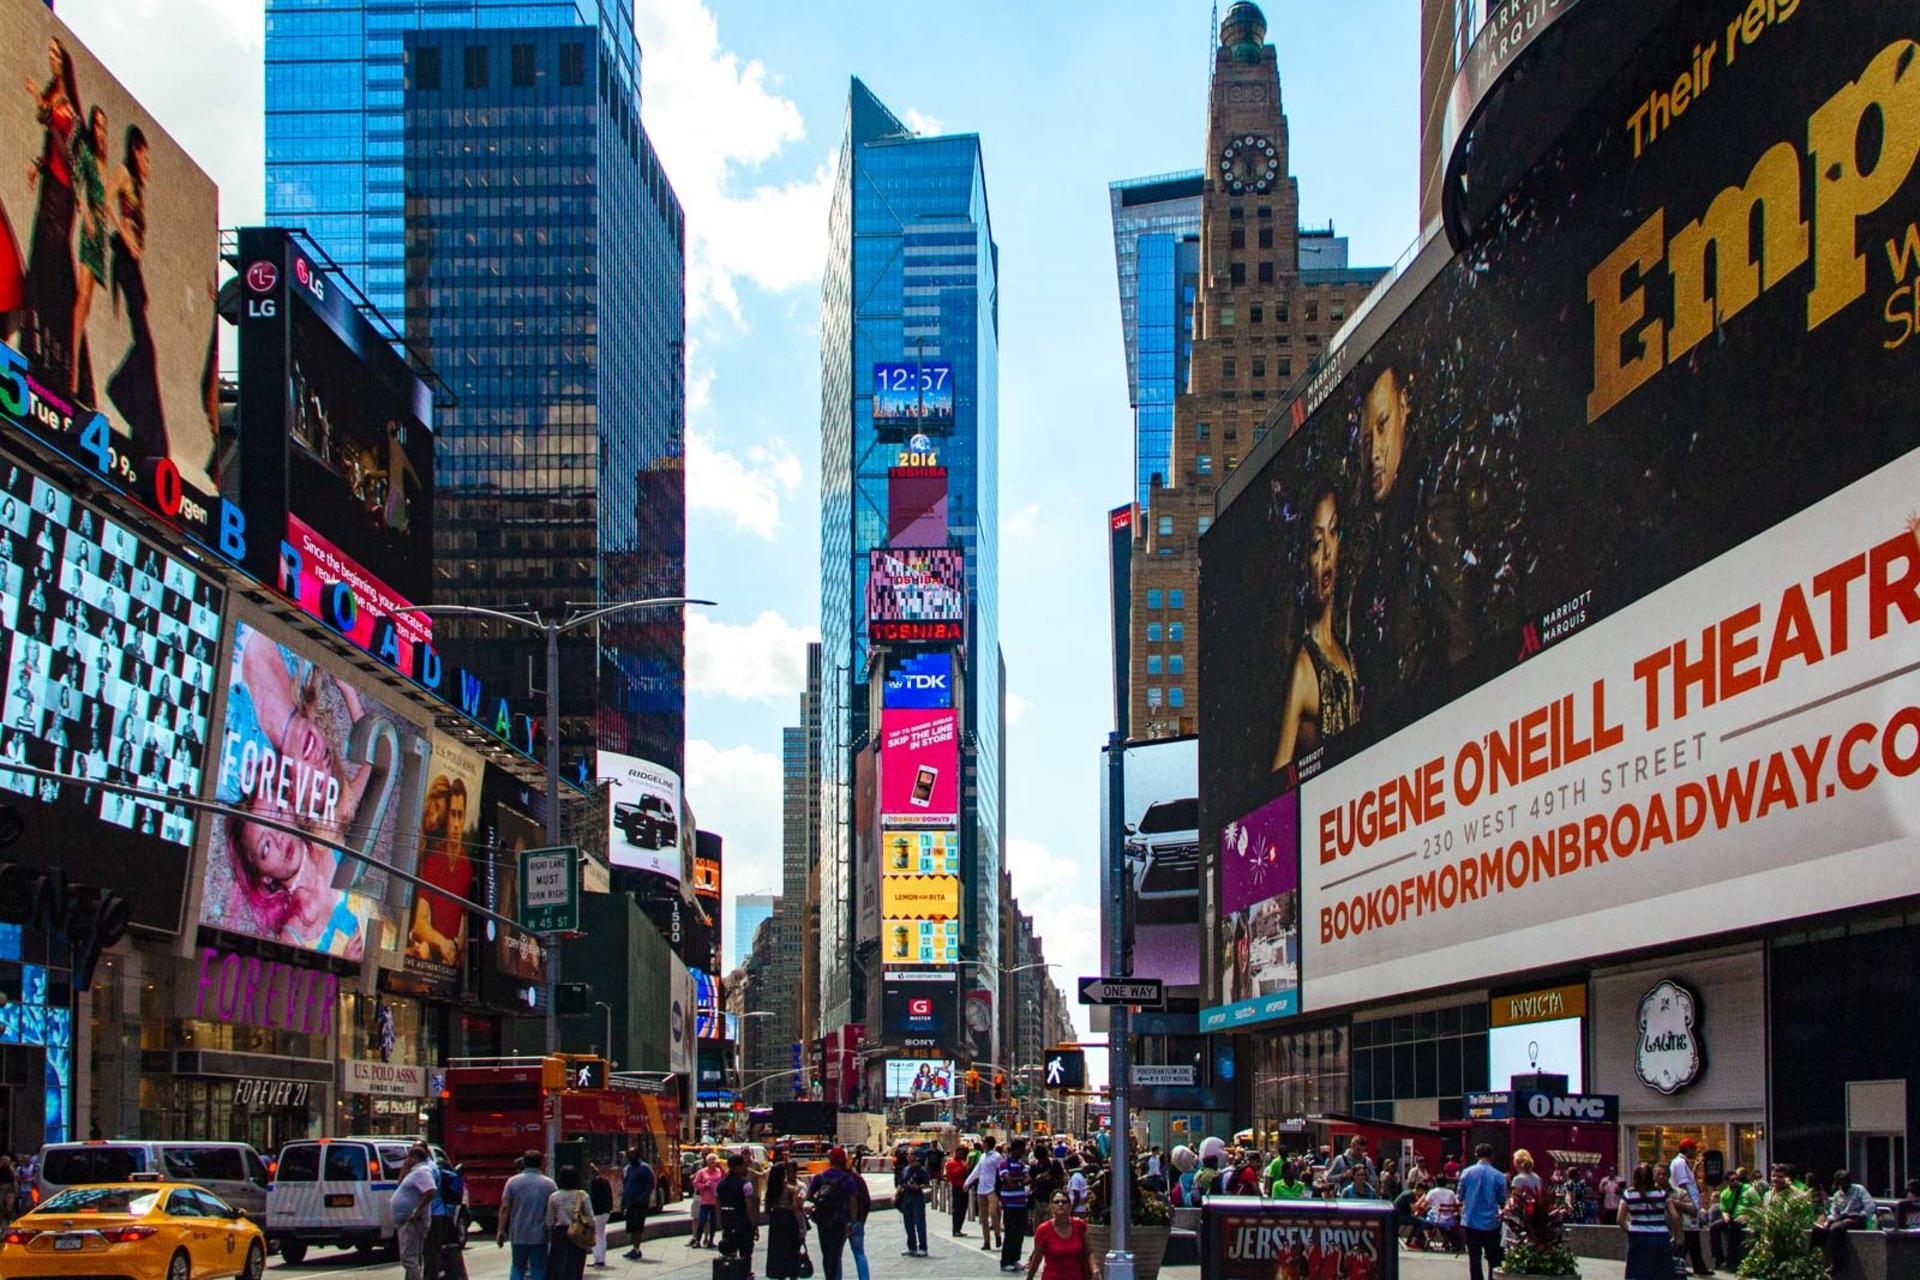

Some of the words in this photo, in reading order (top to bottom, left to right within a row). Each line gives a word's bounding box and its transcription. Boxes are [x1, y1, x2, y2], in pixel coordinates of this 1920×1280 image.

[1478, 0, 1527, 59] MARR
[1627, 40, 1716, 158] Their
[1587, 39, 1920, 425] Emp
[308, 271, 324, 301] LG
[248, 300, 276, 317] LG
[878, 367, 949, 391] 12:57
[1307, 346, 1348, 398] MARRIOTT
[1307, 372, 1343, 416] MARQUIS
[30, 393, 60, 430] Tue
[899, 453, 937, 467] 2016
[302, 534, 325, 562] Since
[326, 551, 341, 573] the
[341, 562, 378, 603] beginning,
[890, 575, 944, 584] TOSHIBA
[1542, 589, 1592, 627] MARRIOTT
[220, 497, 540, 754] BROADWAY
[872, 623, 961, 639] TOSHIBA
[1542, 610, 1586, 644] MARQUIS
[903, 674, 947, 689] TDK
[888, 735, 909, 748] SKIP
[911, 729, 931, 741] THE
[932, 723, 953, 737] LINE
[902, 728, 911, 736] TO
[910, 740, 921, 751] IN
[921, 731, 953, 747] STORE
[1298, 747, 1324, 768] MARRIOTT
[628, 768, 674, 790] RIDGELINE
[1298, 763, 1322, 780] MARQUIS
[1320, 756, 1446, 865] EUGENE
[1453, 678, 1624, 807] O'NEILL
[1423, 830, 1454, 860] 230
[1464, 805, 1518, 845] WEST
[1530, 777, 1586, 820] 49TH
[1601, 732, 1706, 795] STREET
[220, 731, 340, 828] FOREVER
[351, 717, 432, 908] 21
[1320, 706, 1920, 943] BOOKOFMORMONBROADWAY.CO
[530, 860, 547, 870] RIGHT
[549, 858, 566, 869] LANE
[536, 874, 559, 886] MUST
[528, 920, 536, 928] W
[540, 918, 553, 928] 45
[557, 916, 568, 927] ST
[543, 907, 552, 915] AT
[672, 900, 681, 943] 1500
[194, 947, 338, 1036] FOREVER
[1103, 985, 1126, 997] ONE
[1129, 985, 1154, 997] WAY
[912, 1000, 927, 1013] G
[1510, 991, 1565, 1020] INVICTA
[354, 1063, 370, 1080] U.S.
[371, 1065, 395, 1082] POLO
[396, 1067, 419, 1084] ASSN.
[234, 1079, 290, 1106] FOREVER
[290, 1083, 309, 1107] 21
[1553, 1097, 1605, 1118] NYC
[1228, 1226, 1314, 1260] JERSEY
[1319, 1227, 1378, 1262] BOYS
